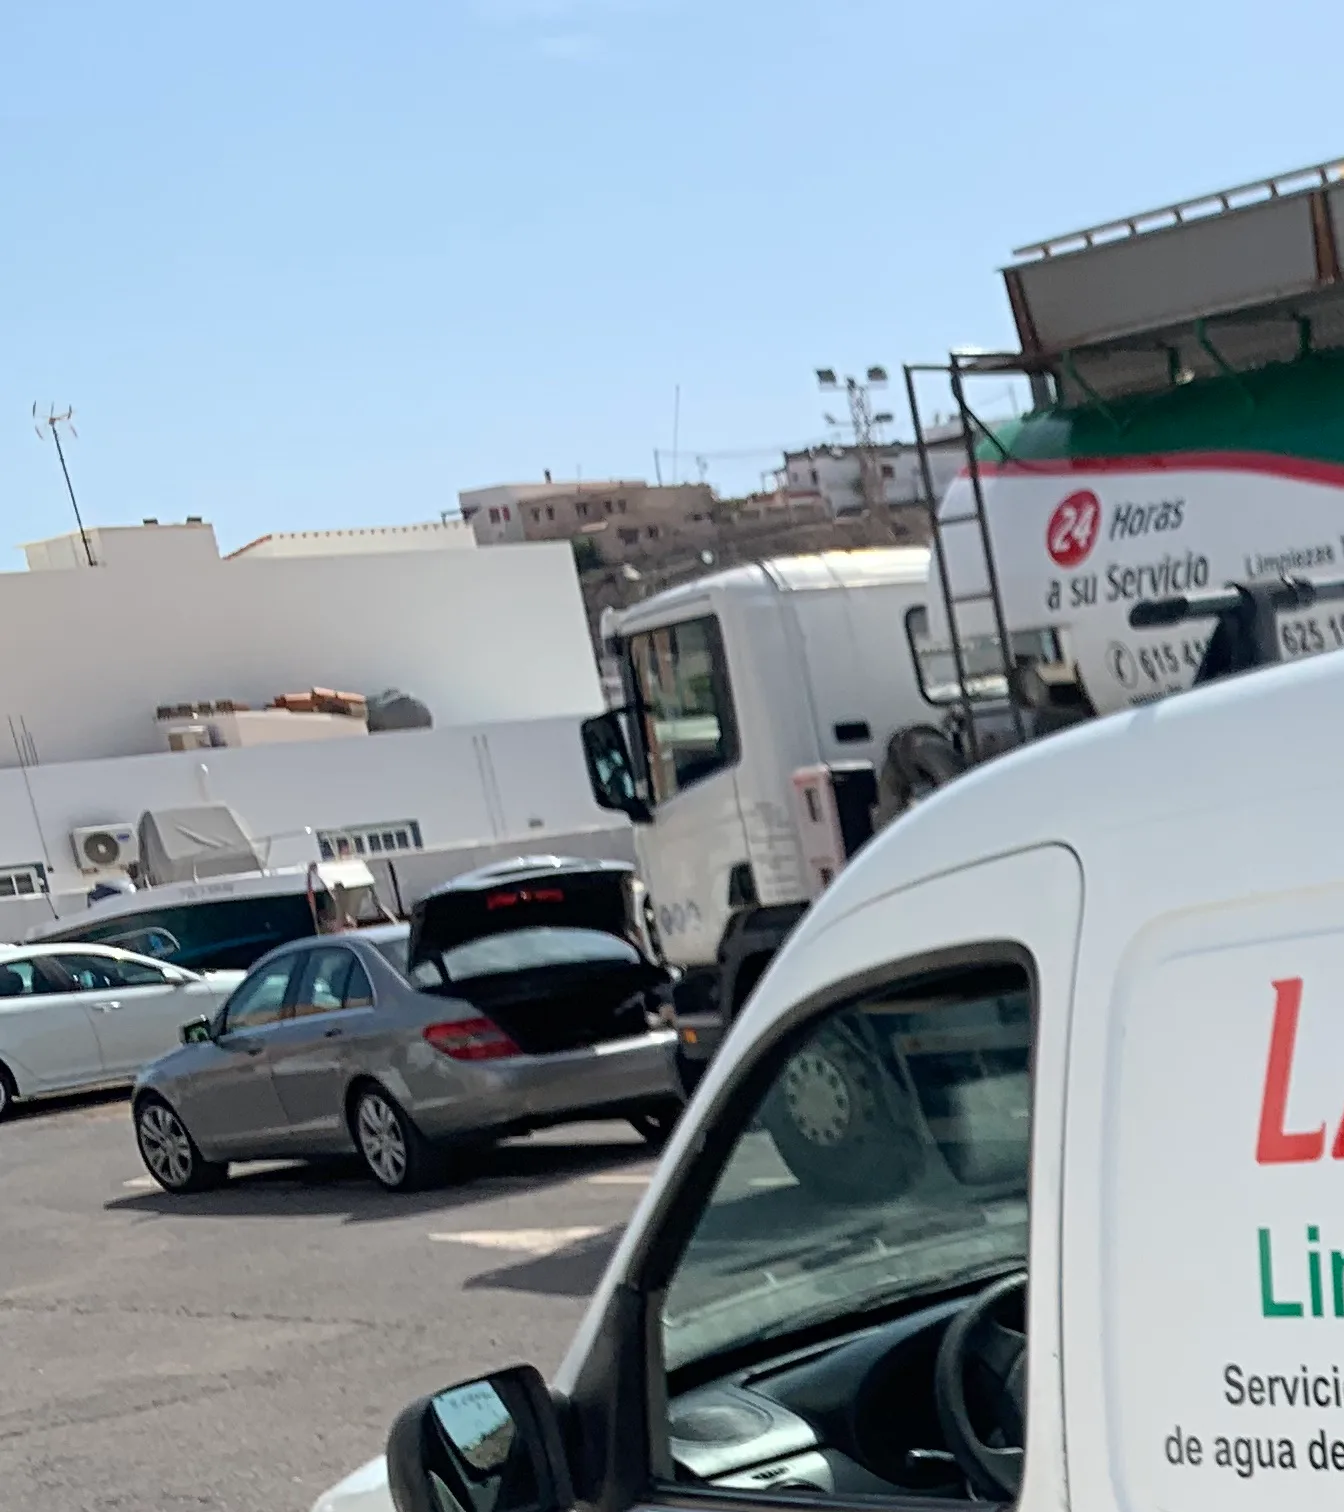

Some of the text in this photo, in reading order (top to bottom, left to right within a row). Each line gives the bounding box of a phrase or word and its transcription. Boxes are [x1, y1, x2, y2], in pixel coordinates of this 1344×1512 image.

[1052, 497, 1186, 553] 24 Horas
[1047, 549, 1210, 611] a su Servicio
[1243, 544, 1336, 580] Limpiezas
[1281, 617, 1325, 656] 625
[1165, 1425, 1203, 1466] de
[1214, 1434, 1297, 1479] agua
